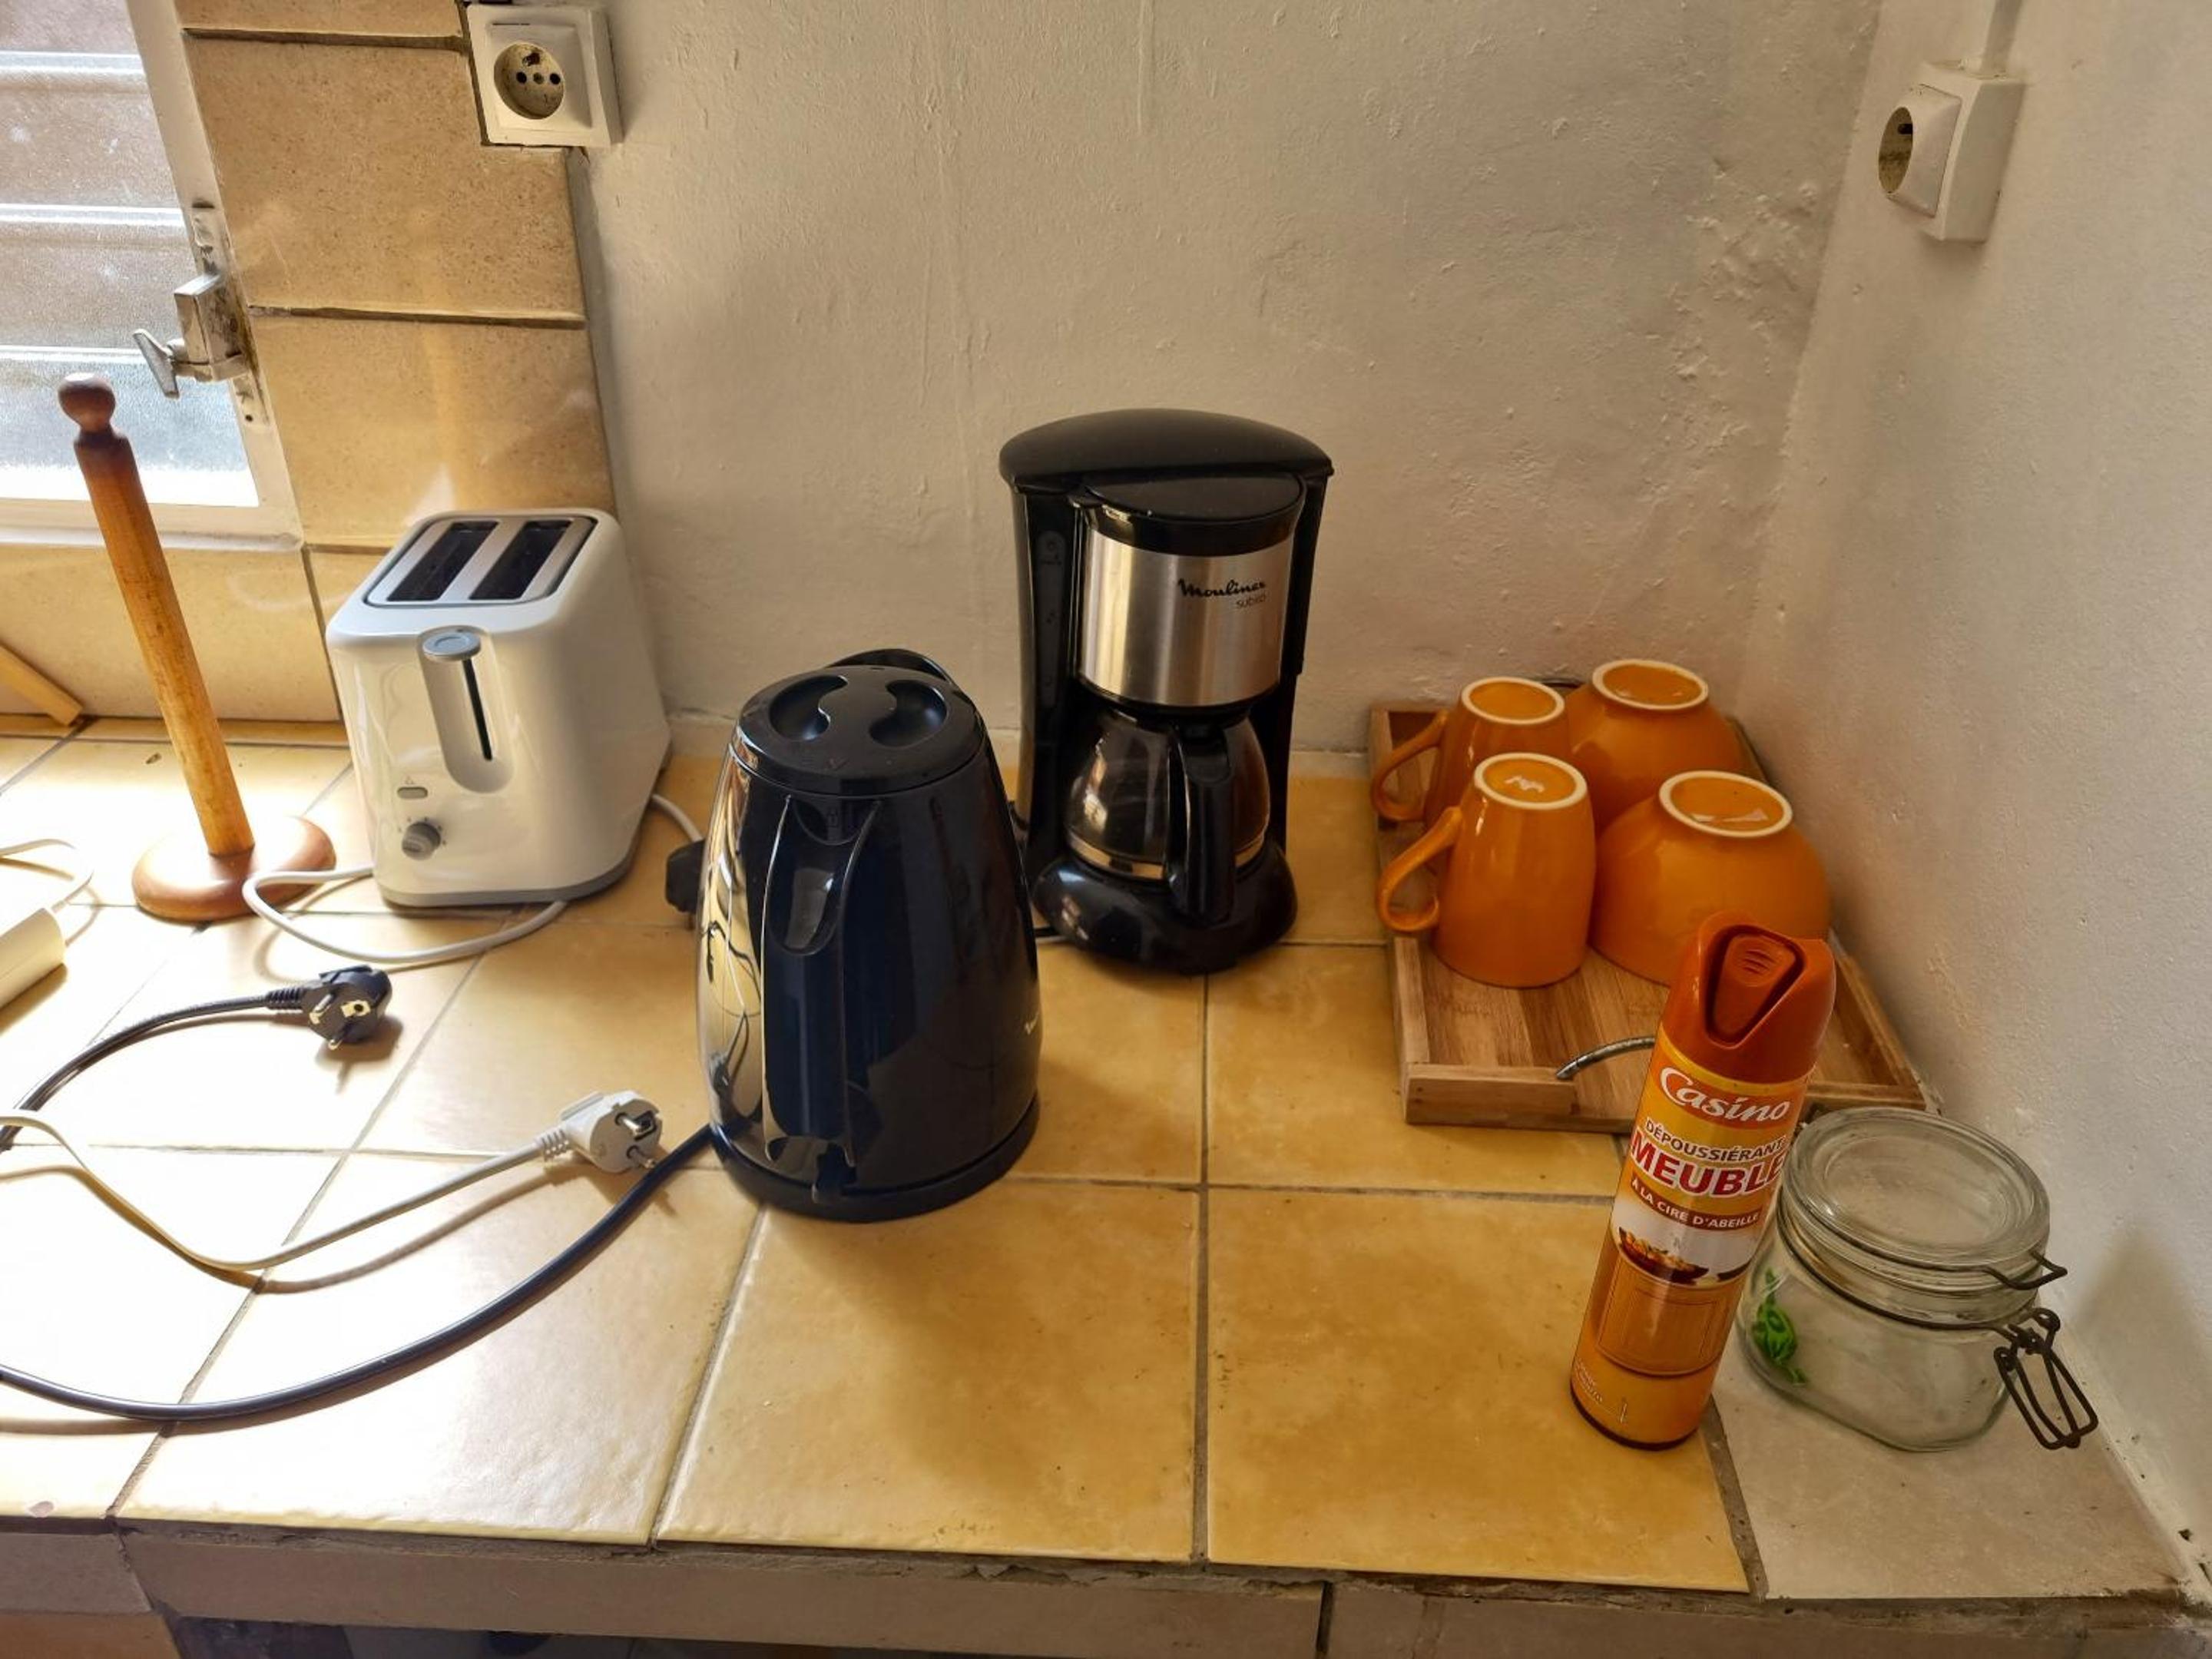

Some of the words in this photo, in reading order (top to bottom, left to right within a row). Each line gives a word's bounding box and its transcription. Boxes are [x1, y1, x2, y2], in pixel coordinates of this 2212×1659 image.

[1660, 1067, 1791, 1121] Casino
[1640, 1187, 1654, 1205] LA
[1657, 1202, 1689, 1222] CIRE
[1692, 1211, 1760, 1228] D'ABEILLE
